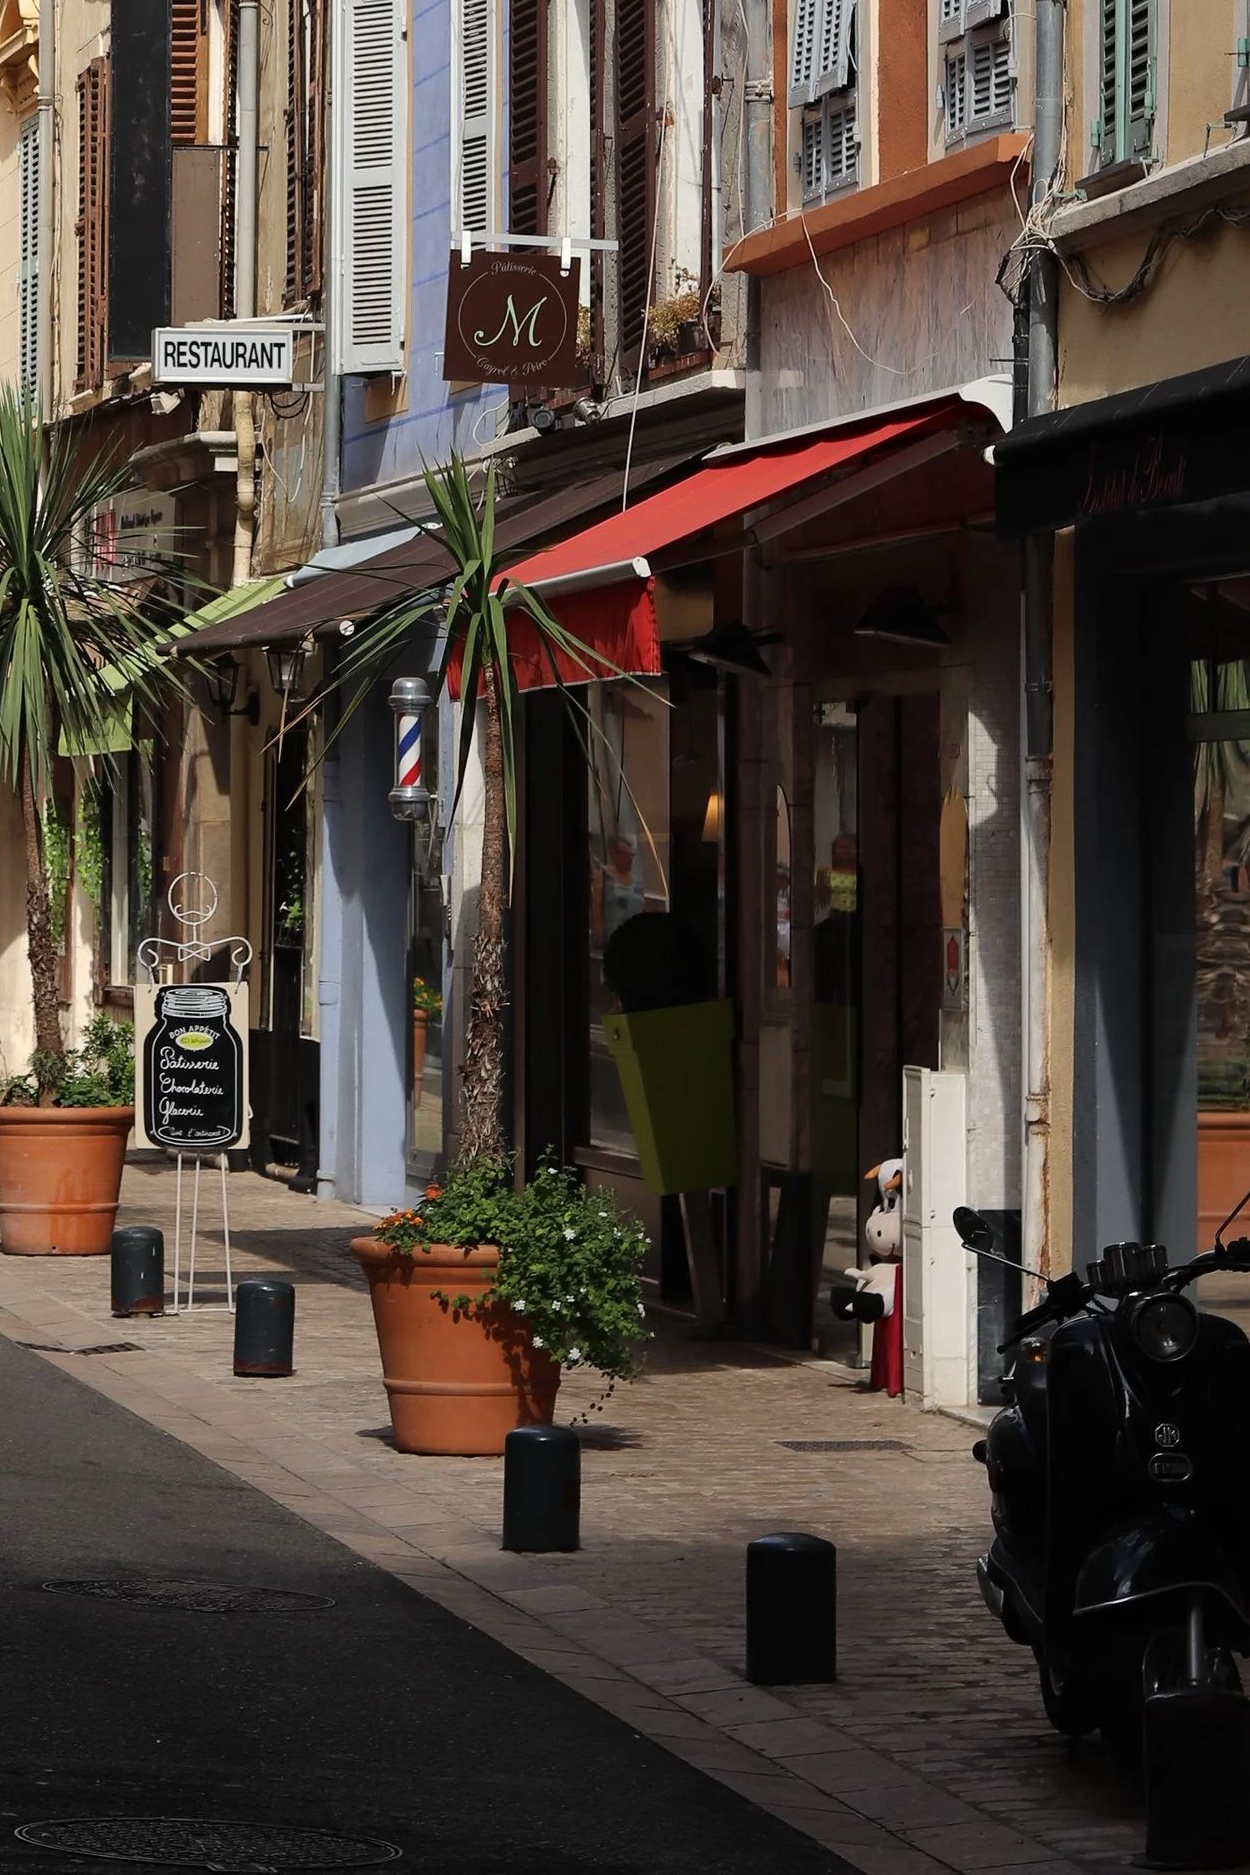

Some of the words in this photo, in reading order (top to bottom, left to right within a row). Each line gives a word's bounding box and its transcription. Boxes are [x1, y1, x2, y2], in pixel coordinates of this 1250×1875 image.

[490, 260, 538, 277] Pâtisserie
[473, 293, 548, 347] M
[164, 340, 286, 369] RESTAURANT
[168, 1026, 186, 1039] BON
[188, 1025, 221, 1040] APPÉTIT
[160, 1046, 220, 1070] Pâtisserie
[159, 1072, 224, 1095] Chocolaterie
[159, 1096, 204, 1125] Glacerie
